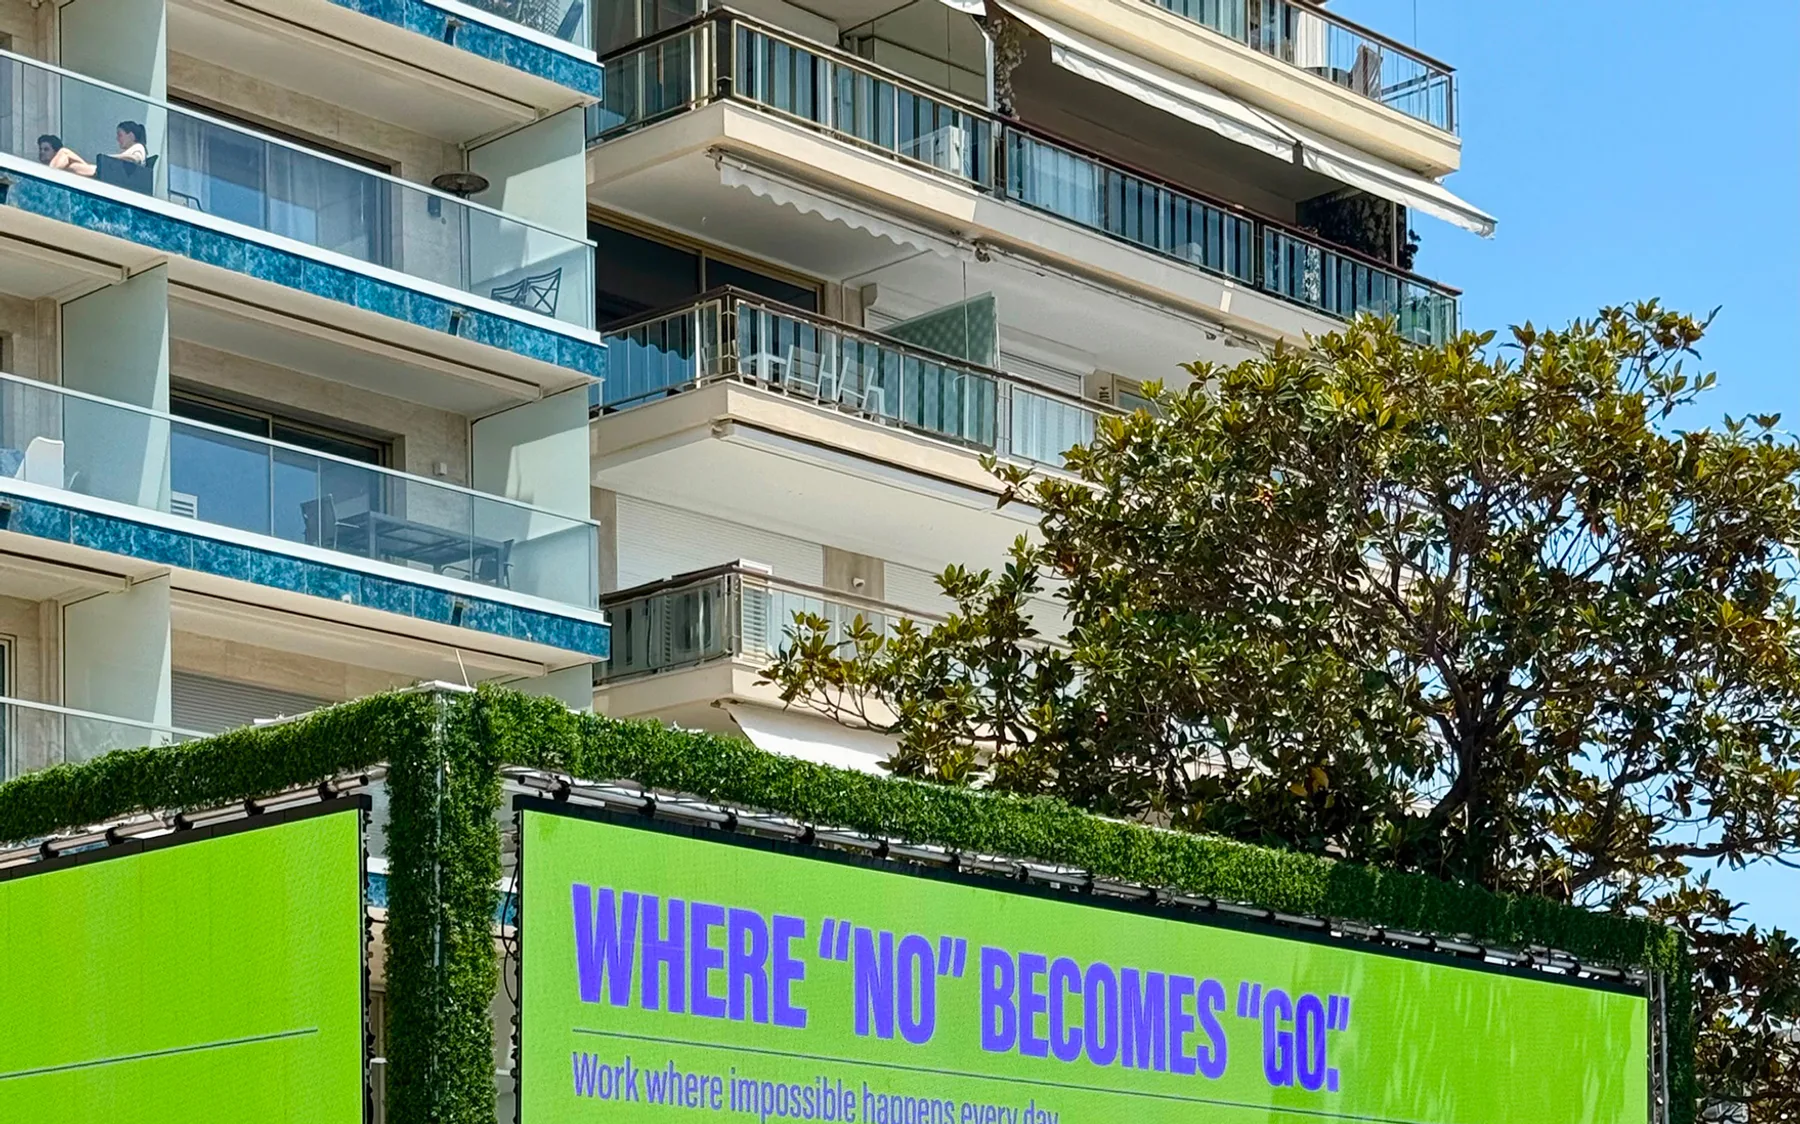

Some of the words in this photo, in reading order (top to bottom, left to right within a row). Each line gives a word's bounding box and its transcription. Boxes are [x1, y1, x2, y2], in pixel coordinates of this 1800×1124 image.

[572, 883, 808, 1029] WHERE
[818, 918, 967, 1045] “NO”
[980, 946, 1228, 1080] BECOMES
[572, 1052, 640, 1103] Work
[645, 1060, 724, 1110] where
[729, 1067, 856, 1124] impossible
